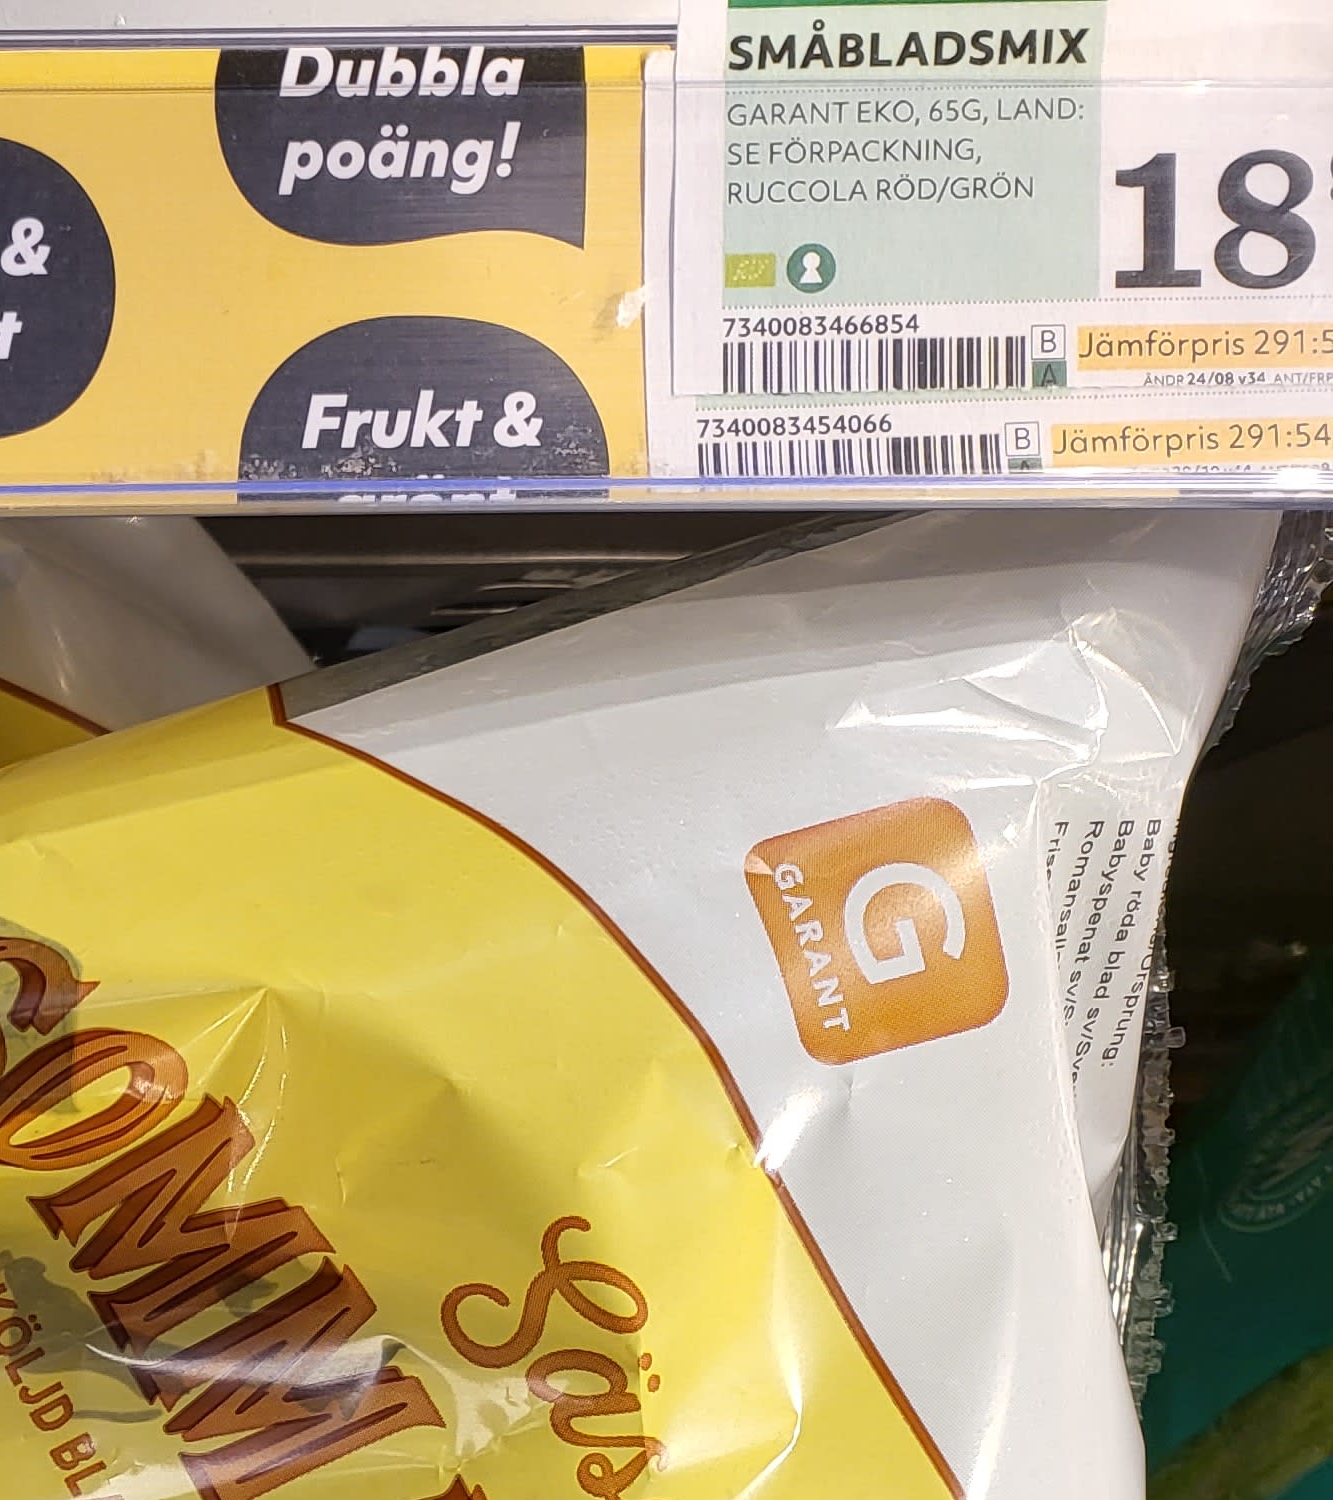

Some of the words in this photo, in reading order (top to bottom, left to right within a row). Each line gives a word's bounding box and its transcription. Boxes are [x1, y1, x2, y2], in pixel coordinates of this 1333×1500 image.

[728, 18, 1090, 70] SMÅBLADSMIX
[279, 46, 525, 98] Dubbla
[727, 101, 850, 126] GARANT
[857, 99, 921, 127] EKO,
[928, 98, 989, 125] 65G,
[997, 97, 1085, 122] LAND:
[277, 121, 522, 195] poäng!
[727, 141, 760, 165] SE
[769, 137, 982, 164] FÖRPACKNING,
[727, 179, 868, 205] RUCCOLA
[876, 171, 1034, 202] RÖD/GRÖN
[1115, 148, 1316, 290] 18
[1, 218, 51, 276] &
[722, 313, 921, 338] 7340083466854
[1040, 329, 1057, 353] B
[1079, 329, 1245, 363] Jämförpris
[1186, 371, 1235, 386] 24/08
[1238, 371, 1266, 384] v34
[301, 389, 483, 449] Frukt
[493, 390, 544, 447] &
[696, 413, 893, 438] 7340083454066
[1014, 427, 1031, 450] B
[1053, 425, 1220, 458] Jämförpris
[1229, 422, 1332, 449] 291:54
[1133, 819, 1162, 882] Baby
[1074, 819, 1134, 964] Babyspenat
[1114, 889, 1143, 943] röda
[774, 862, 850, 1034] GARANT
[844, 861, 966, 985] G
[1093, 951, 1126, 1000] blad
